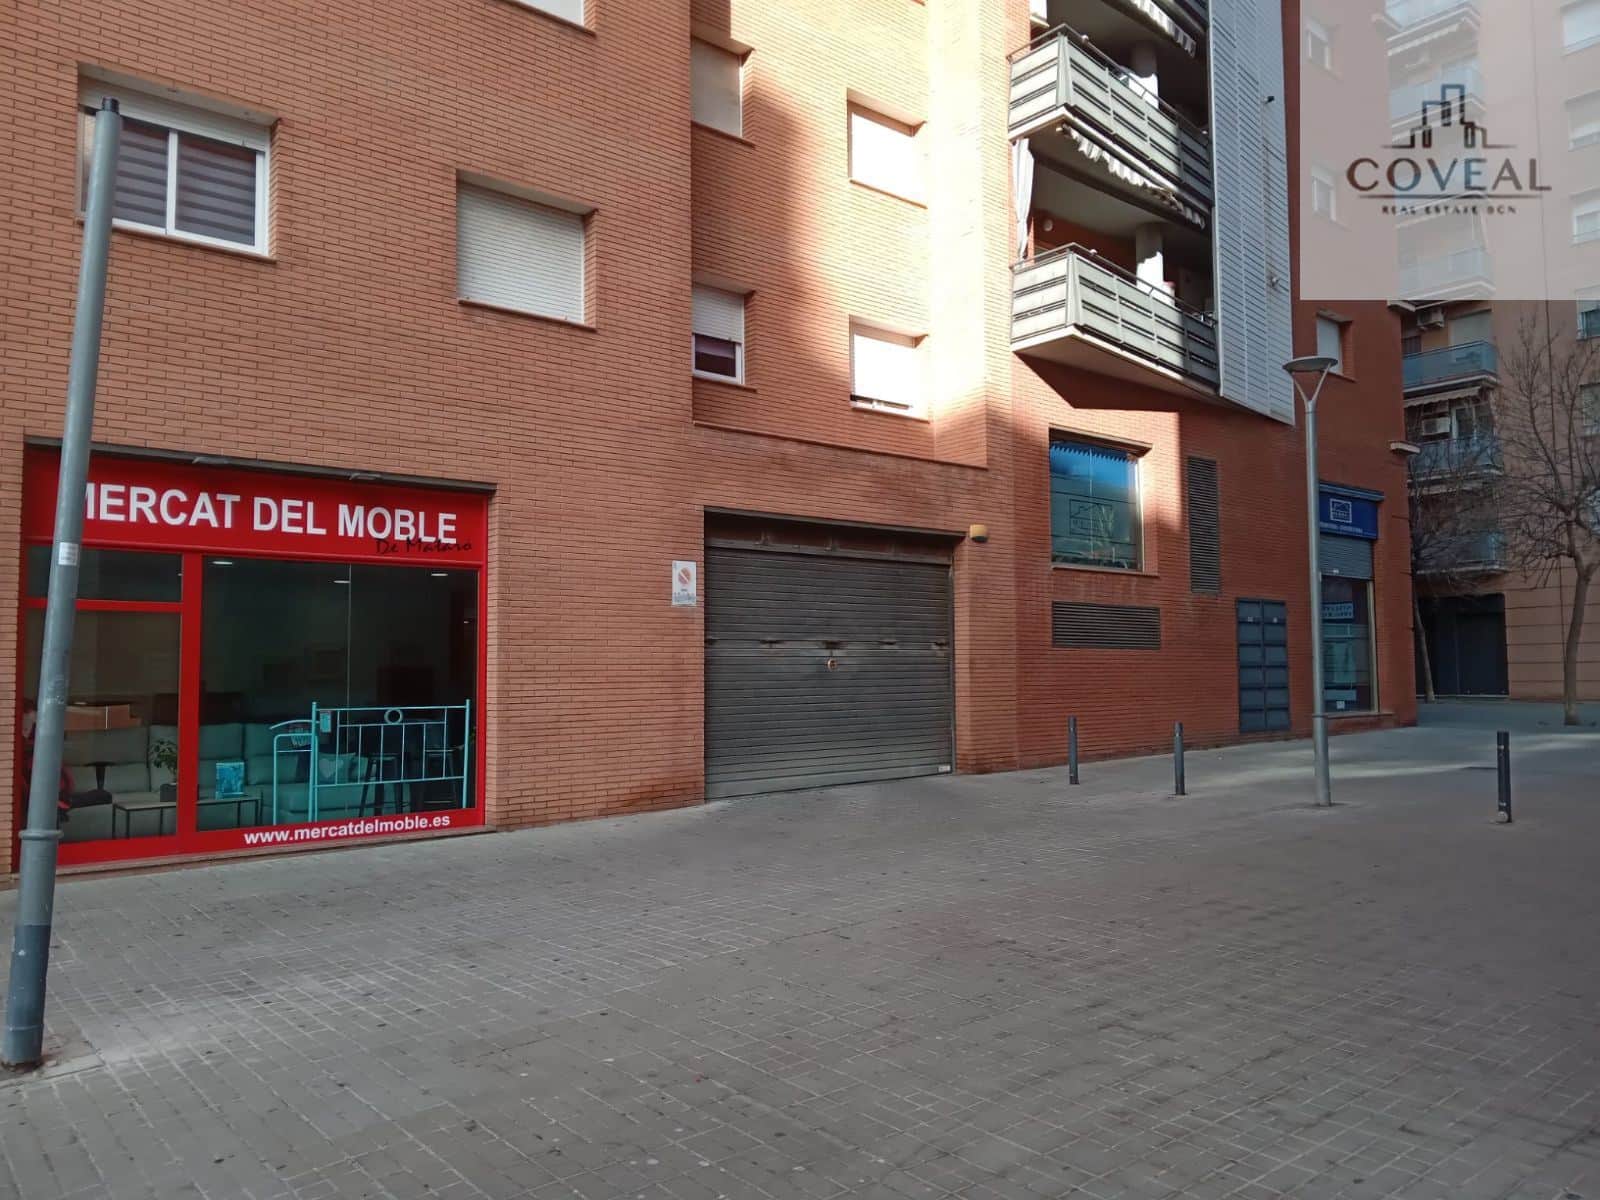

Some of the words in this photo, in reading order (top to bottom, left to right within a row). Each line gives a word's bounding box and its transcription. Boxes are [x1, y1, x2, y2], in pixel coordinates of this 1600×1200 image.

[253, 497, 327, 535] DEL
[338, 504, 456, 544] MOBLE
[244, 815, 450, 844] www.mercatdelmoble.es
